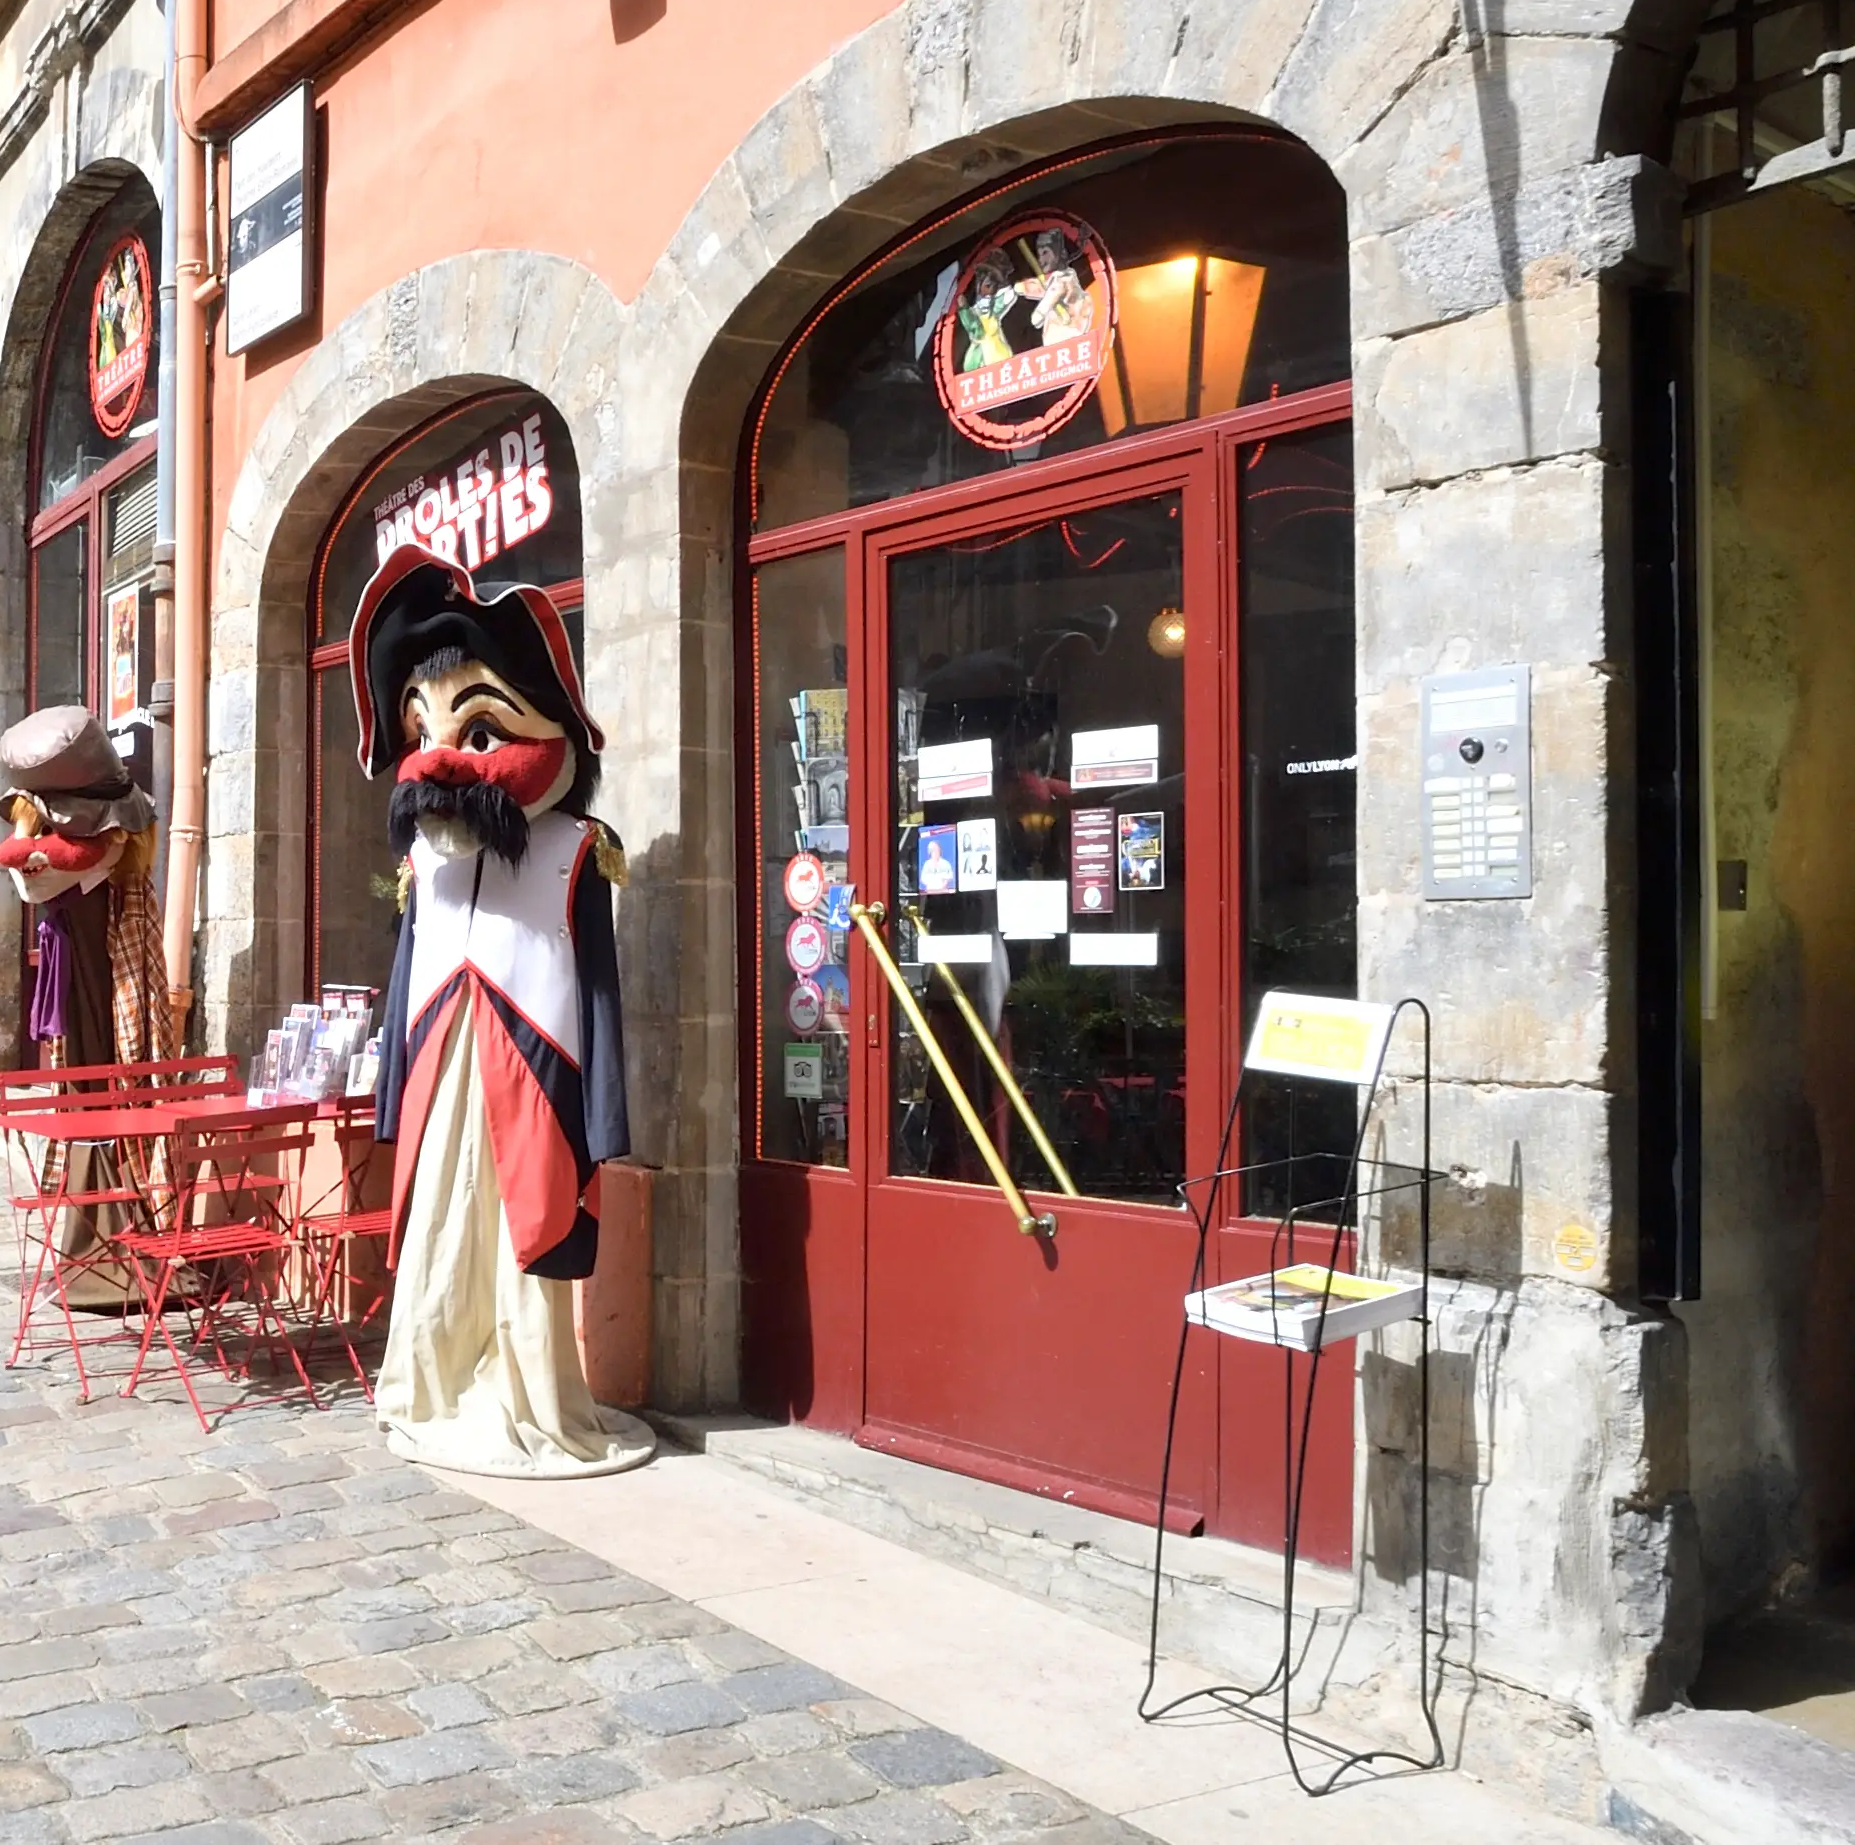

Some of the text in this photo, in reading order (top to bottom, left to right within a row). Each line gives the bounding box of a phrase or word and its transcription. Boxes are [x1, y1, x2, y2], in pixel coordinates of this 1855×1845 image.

[960, 341, 1092, 397] THÉÂTRE
[961, 361, 1092, 408] LA MAISON DE GUIGNOL
[500, 412, 546, 483] DE
[373, 476, 425, 521] THÉÂTRE DES
